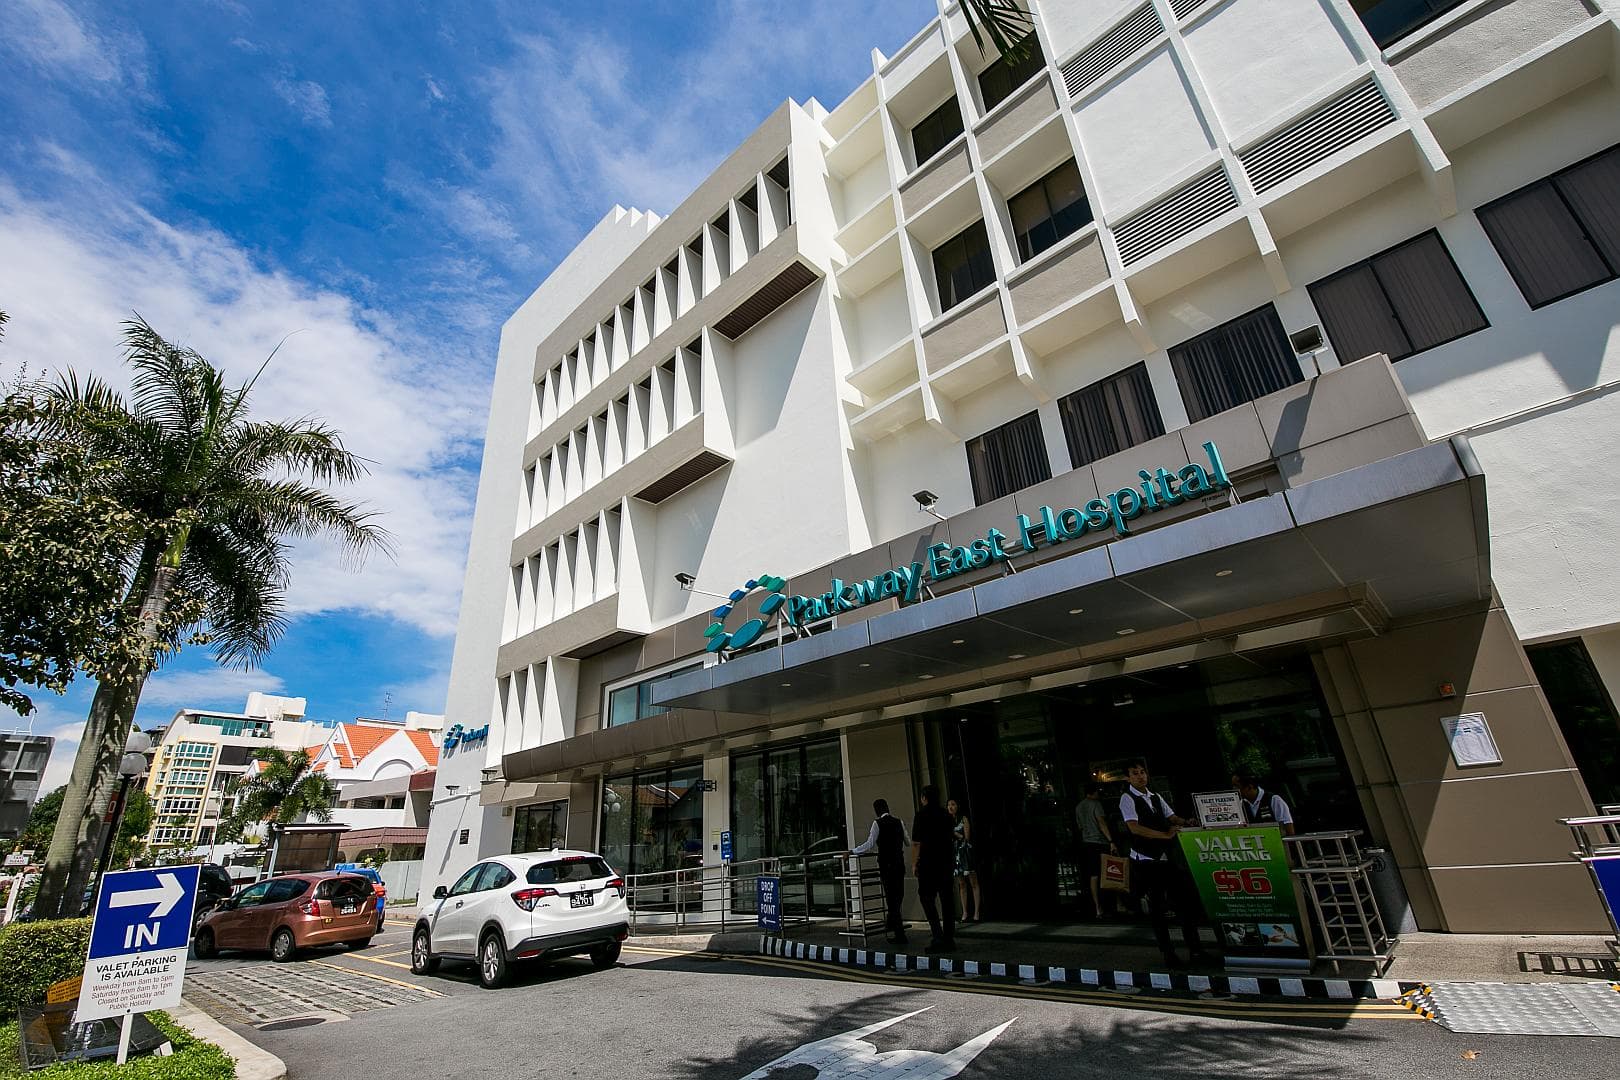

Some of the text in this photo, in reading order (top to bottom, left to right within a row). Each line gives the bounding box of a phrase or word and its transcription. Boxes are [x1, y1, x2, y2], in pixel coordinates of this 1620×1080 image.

[788, 440, 1233, 626] Parkway East Hospital
[1195, 835, 1265, 851] VALET
[1200, 850, 1272, 863] PARKING
[760, 881, 774, 891] DROP
[1213, 867, 1272, 896] $6
[763, 893, 773, 903] OFF
[760, 904, 776, 915] POINT
[124, 922, 160, 948] IN
[96, 955, 177, 973] VALET PARKING
[101, 964, 170, 981] IS AVAILABLE
[92, 982, 121, 992] Weekday
[122, 980, 137, 988] from
[91, 989, 120, 1000] Saturday
[121, 987, 136, 995] from
[97, 996, 119, 1006] Closed
[129, 991, 152, 1001] Sunday
[153, 989, 166, 997] and
[109, 999, 152, 1010] Public Holiday
